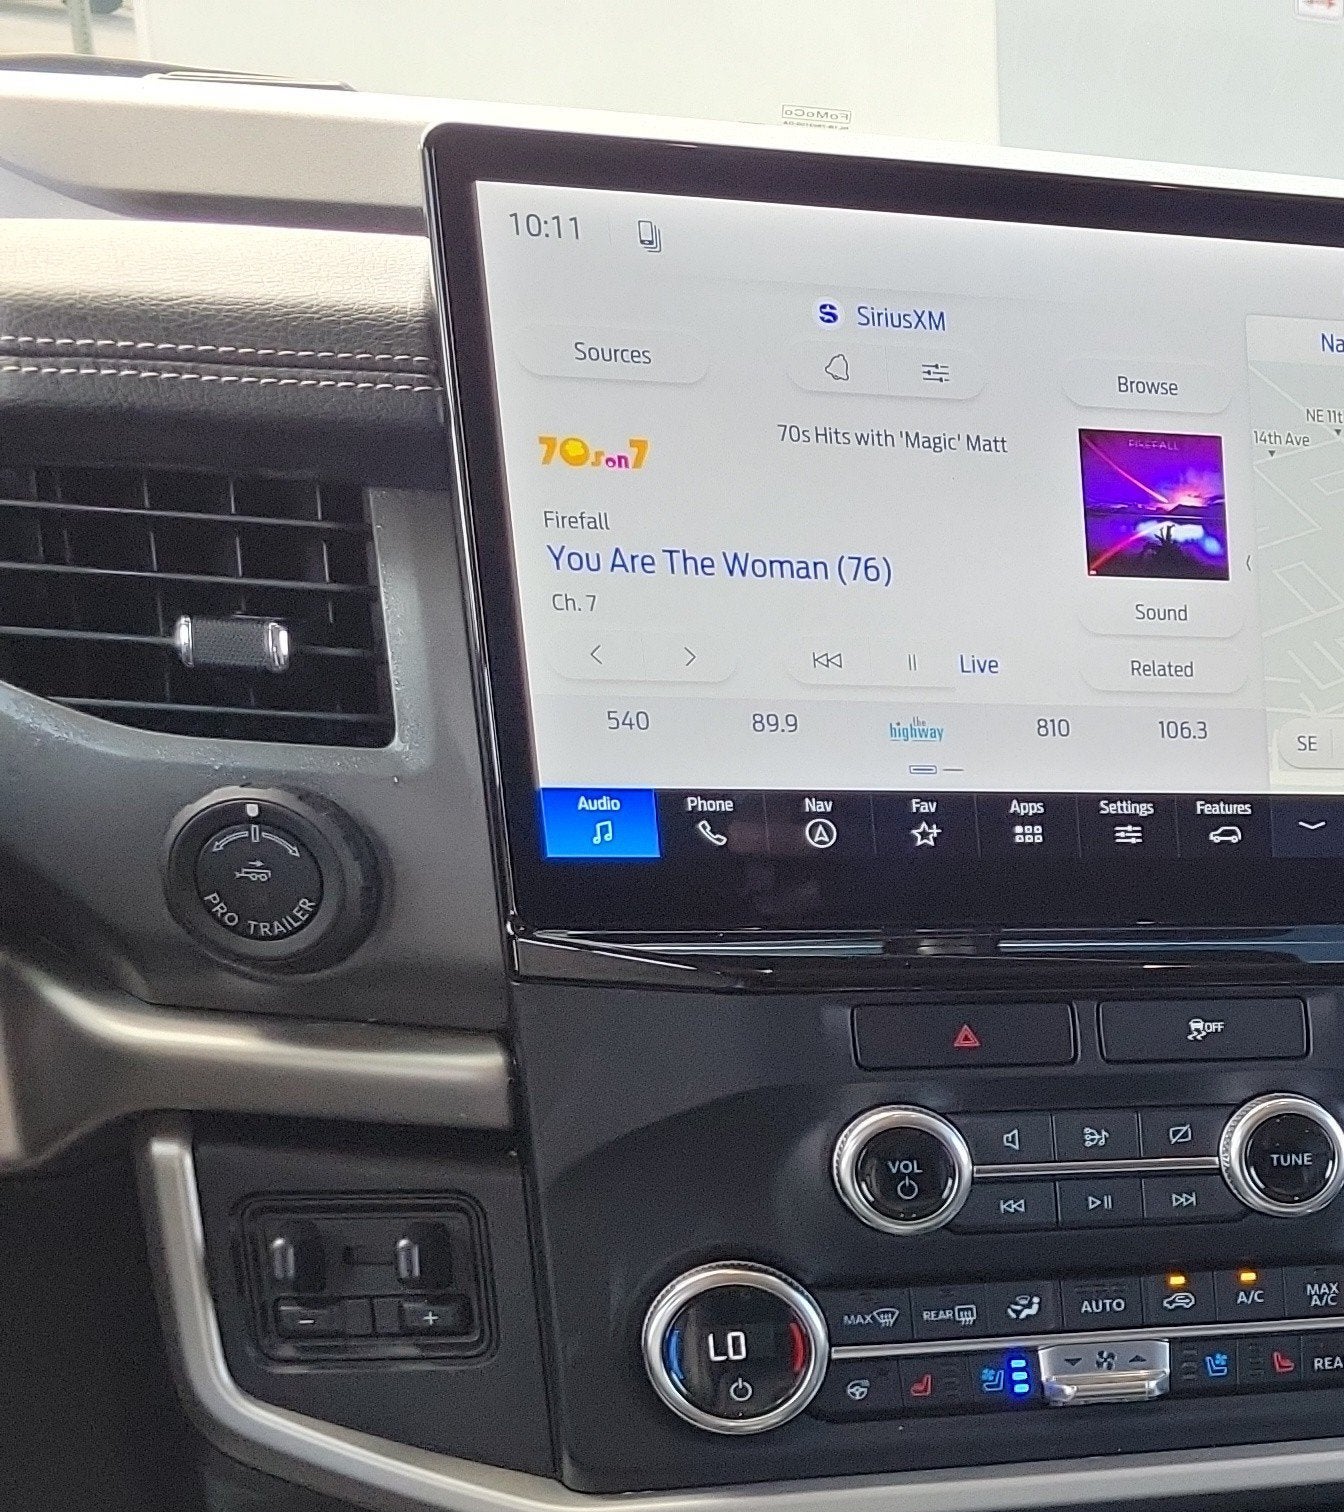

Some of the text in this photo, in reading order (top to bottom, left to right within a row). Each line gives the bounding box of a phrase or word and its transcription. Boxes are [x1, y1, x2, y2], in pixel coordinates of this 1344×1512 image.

[508, 212, 581, 241] 10:11
[856, 304, 947, 332] SiriusXM
[573, 341, 652, 365] Sources
[1116, 375, 1179, 396] Browse
[1305, 409, 1325, 424] NE
[778, 424, 1008, 454] 70s Hits with 'Magic' Matt
[1253, 430, 1310, 447] 14th Ave
[543, 510, 611, 531] Firefall
[546, 544, 893, 586] You Are The Woman (76)
[551, 593, 597, 612] Ch. 7
[1134, 603, 1189, 622] Sound
[960, 655, 999, 674] Live
[1130, 660, 1194, 678] Related
[606, 710, 650, 731] 540
[751, 712, 799, 734] 89.9
[1036, 718, 1071, 738] 810
[1157, 719, 1208, 740] 106.3
[889, 722, 944, 742] highway
[1297, 735, 1318, 752] SE
[577, 796, 621, 812] Audio
[687, 797, 734, 813] Phone
[804, 797, 833, 813] Nav
[911, 798, 937, 814] Fav
[1009, 799, 1045, 817] Apps
[1099, 799, 1155, 817] Settings
[1195, 800, 1252, 815] Features
[203, 892, 317, 936] PRO TRAILER
[1204, 1021, 1225, 1033] OFF
[887, 1160, 923, 1176] VOL
[1270, 1152, 1313, 1167] TUNE
[1236, 1289, 1265, 1304] A/C
[1306, 1282, 1339, 1296] MAX
[1080, 1298, 1126, 1314] AUTO
[1310, 1293, 1338, 1307] A/C
[843, 1313, 873, 1325] MAX
[922, 1309, 954, 1321] REAR
